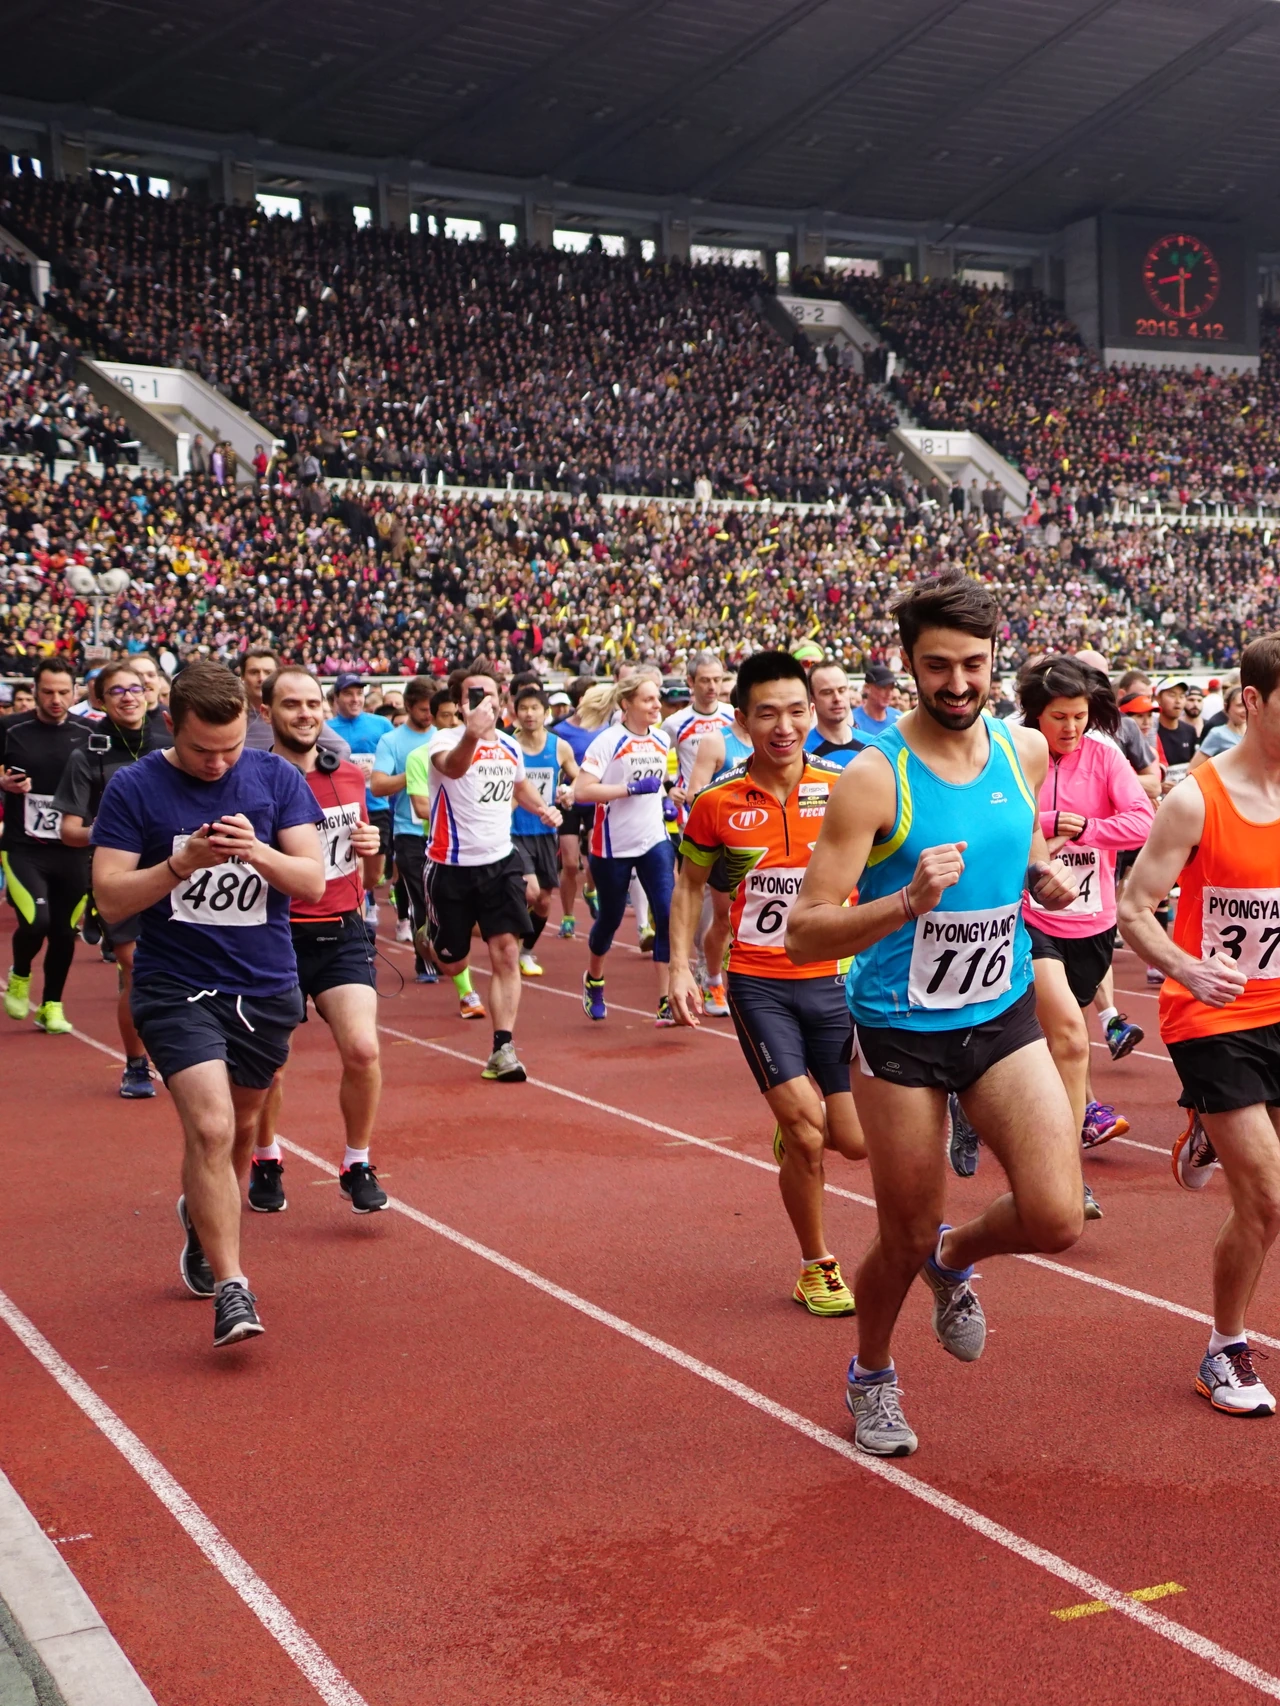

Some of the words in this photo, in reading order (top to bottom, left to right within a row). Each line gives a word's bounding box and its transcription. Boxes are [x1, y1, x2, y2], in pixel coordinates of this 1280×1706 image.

[181, 869, 262, 912] 480
[922, 914, 1016, 944] PYONGYANG
[926, 939, 1010, 995] 116
